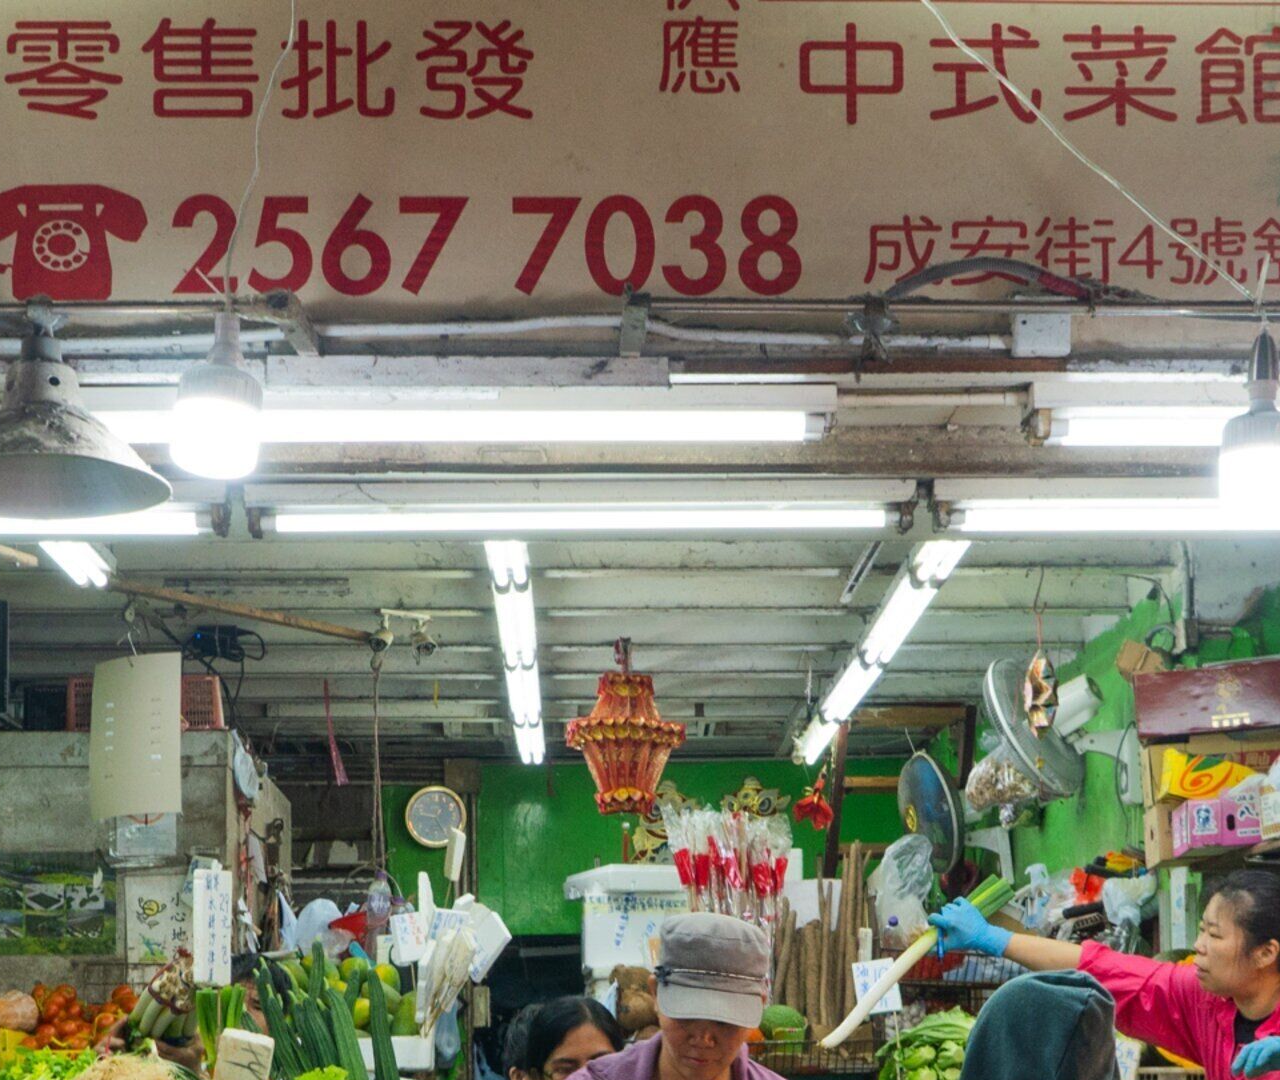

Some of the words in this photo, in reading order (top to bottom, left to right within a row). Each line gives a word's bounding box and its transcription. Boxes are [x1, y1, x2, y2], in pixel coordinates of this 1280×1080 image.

[6, 20, 533, 119] 零售批發
[169, 193, 470, 295] 2567
[510, 194, 801, 296] 7038
